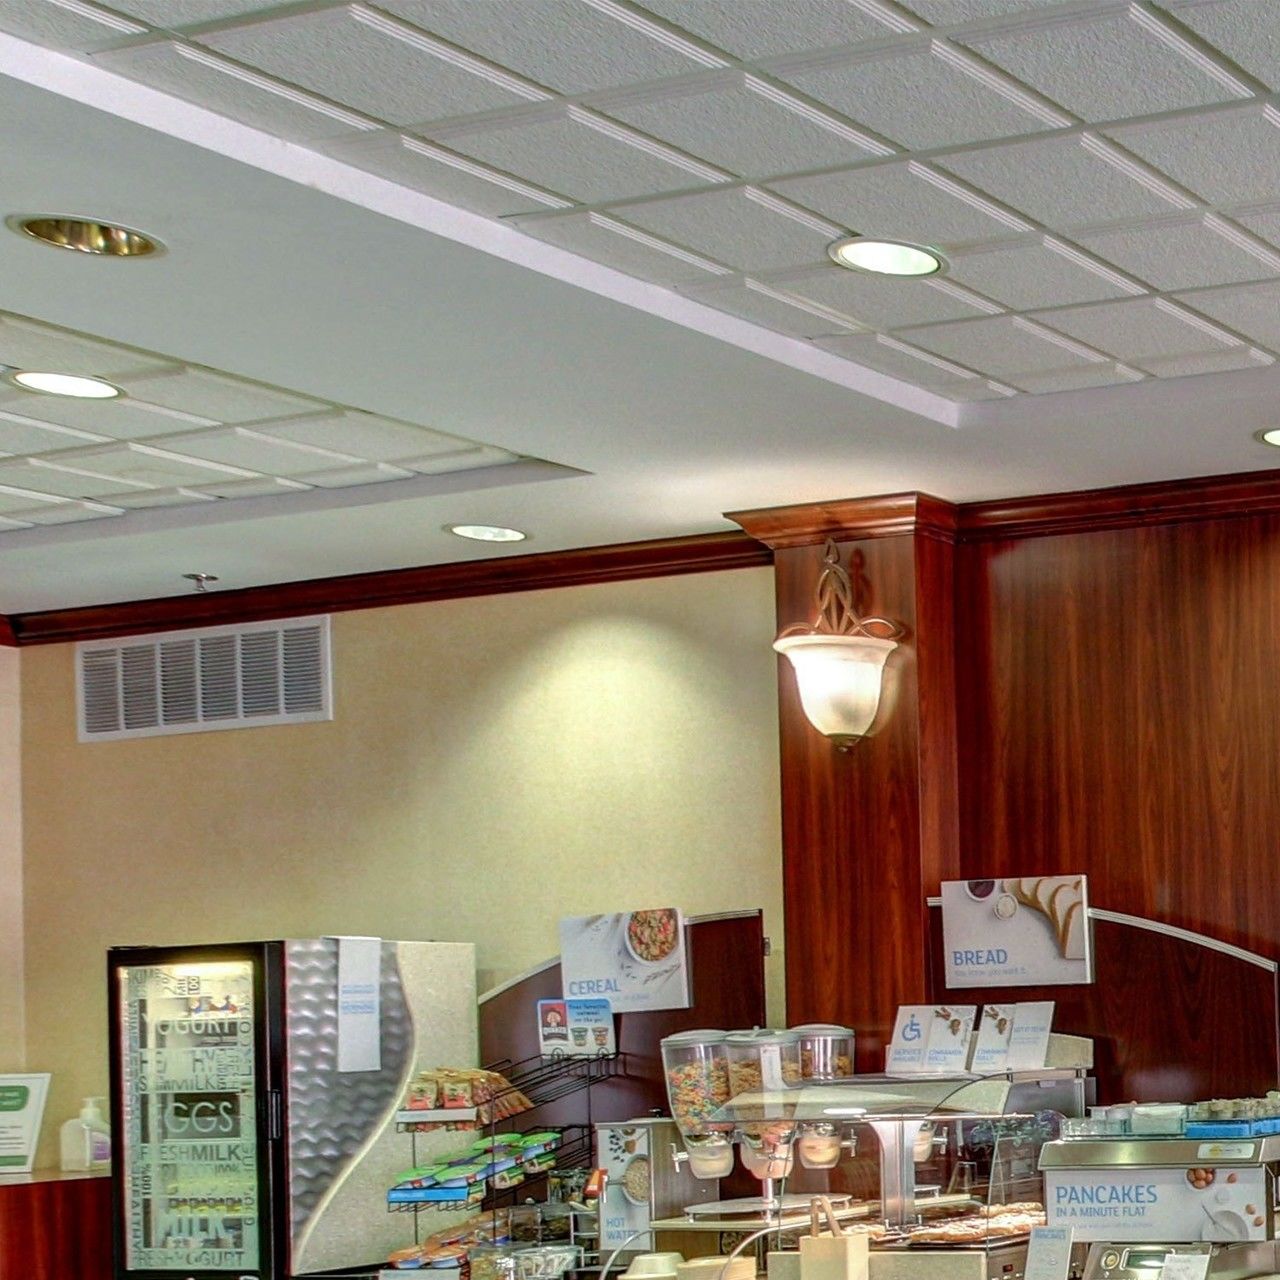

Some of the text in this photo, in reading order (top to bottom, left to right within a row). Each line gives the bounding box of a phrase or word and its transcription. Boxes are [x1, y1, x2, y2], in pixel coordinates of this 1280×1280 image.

[953, 948, 1008, 966] BREAD
[568, 979, 622, 996] CEREAL
[1056, 1184, 1158, 1204] PANCAKES
[1056, 1205, 1146, 1218] IN A MINUTE FLAT
[606, 1217, 625, 1227] HOT
